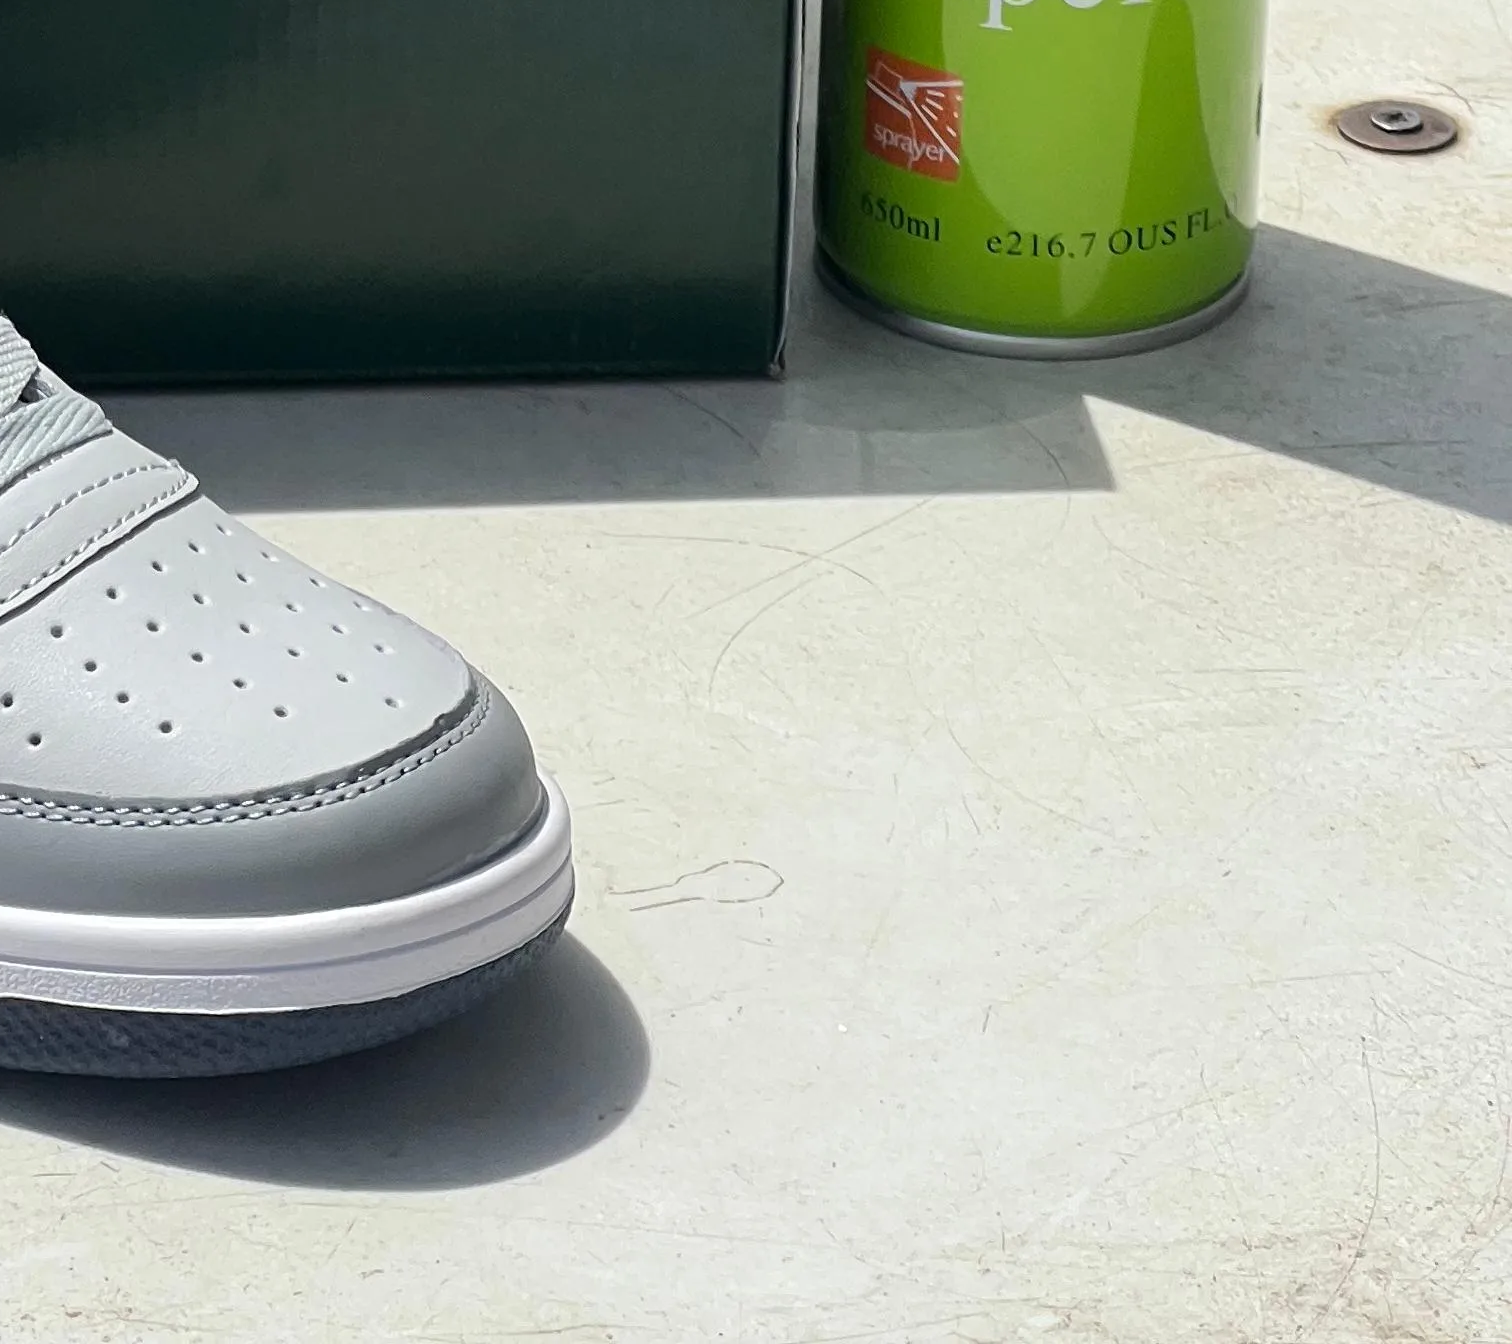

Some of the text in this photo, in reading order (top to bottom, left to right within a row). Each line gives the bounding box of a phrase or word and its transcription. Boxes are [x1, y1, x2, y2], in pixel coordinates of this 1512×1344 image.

[873, 123, 947, 165] sprayer
[861, 193, 941, 242] 650ml
[1108, 220, 1178, 255] OUS
